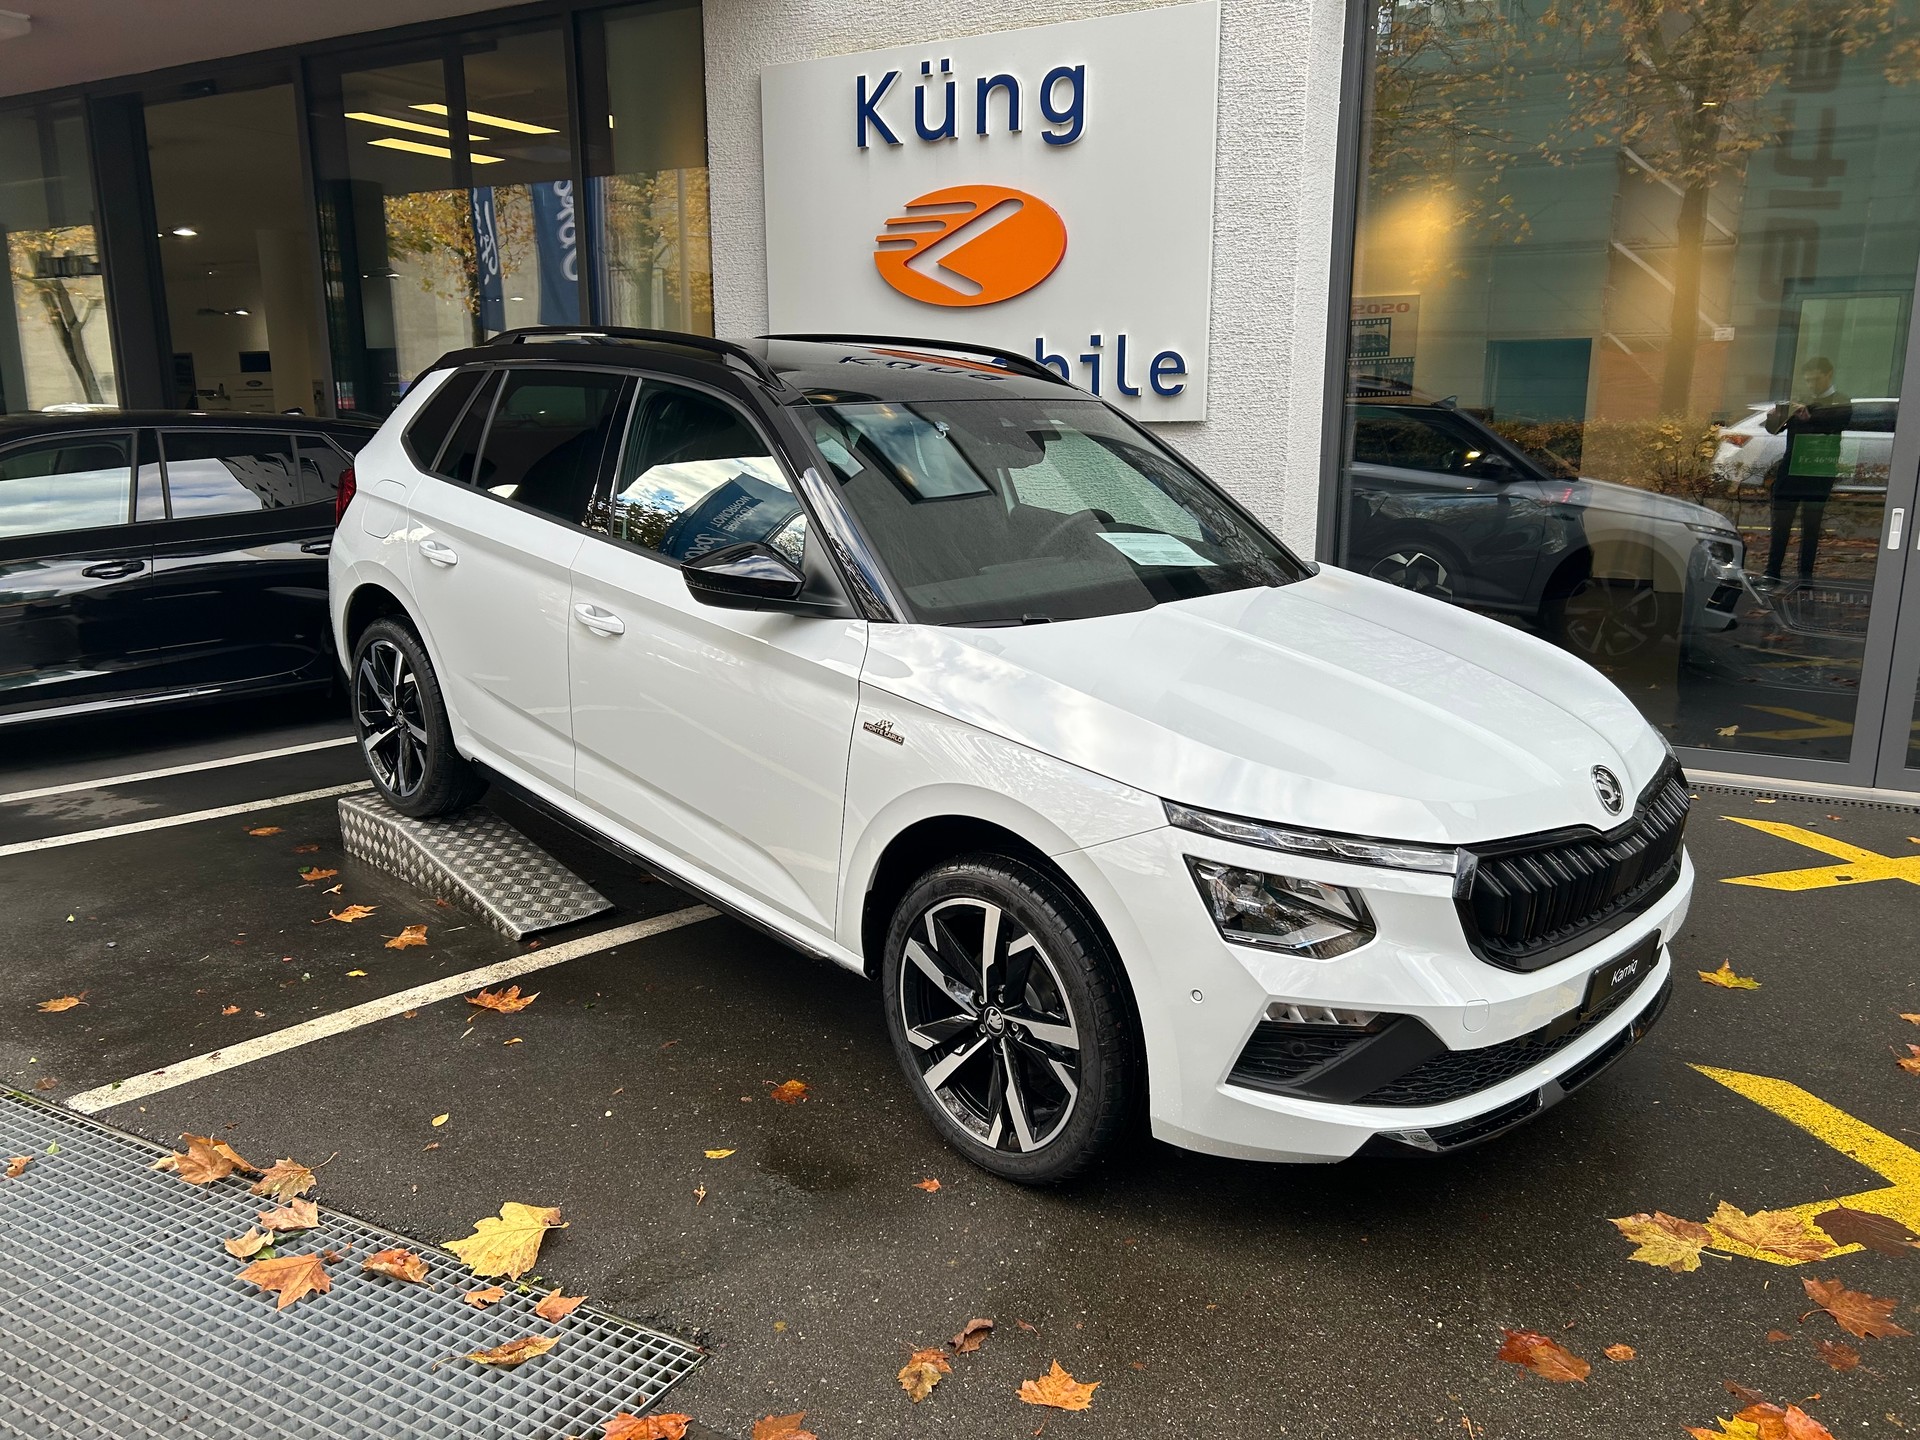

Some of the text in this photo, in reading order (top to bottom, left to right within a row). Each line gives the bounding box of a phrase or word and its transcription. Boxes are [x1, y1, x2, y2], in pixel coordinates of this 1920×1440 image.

[856, 58, 1087, 149] Küng
[864, 723, 902, 743] MONTE CARLO
[1611, 959, 1639, 986] Kamiq
